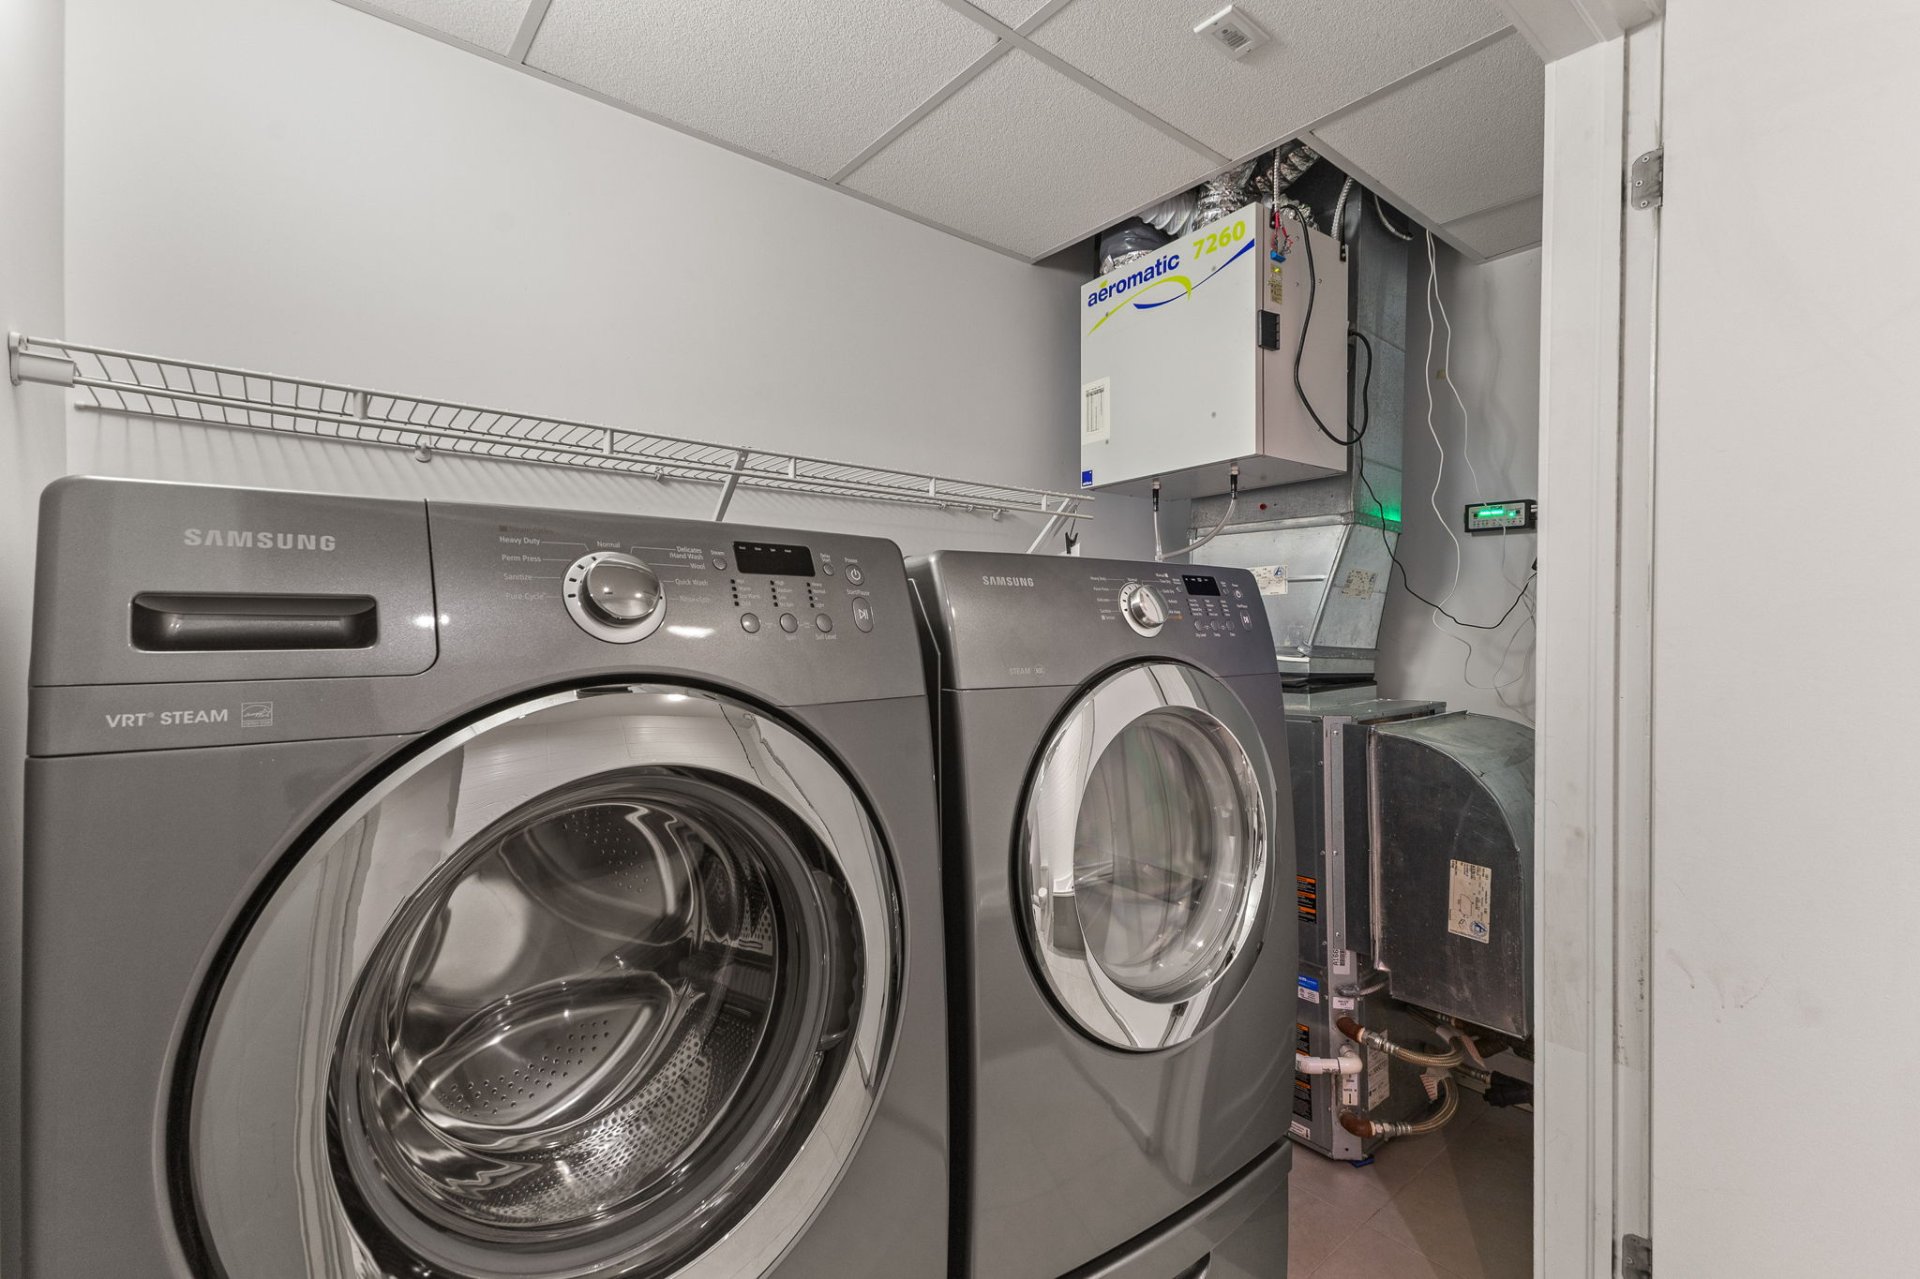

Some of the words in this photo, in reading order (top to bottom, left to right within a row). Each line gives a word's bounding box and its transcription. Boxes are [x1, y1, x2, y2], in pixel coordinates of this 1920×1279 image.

[1193, 220, 1246, 260] 7260
[183, 528, 336, 551] SAMSUNG
[499, 536, 522, 546] Heavy
[523, 536, 541, 547] Duty
[597, 540, 621, 548] Normal
[501, 553, 521, 562] Perm
[522, 554, 542, 562] Press
[503, 572, 532, 581] Sanitize
[982, 575, 1035, 588] SAMSUNG
[160, 708, 229, 725] STEAM
